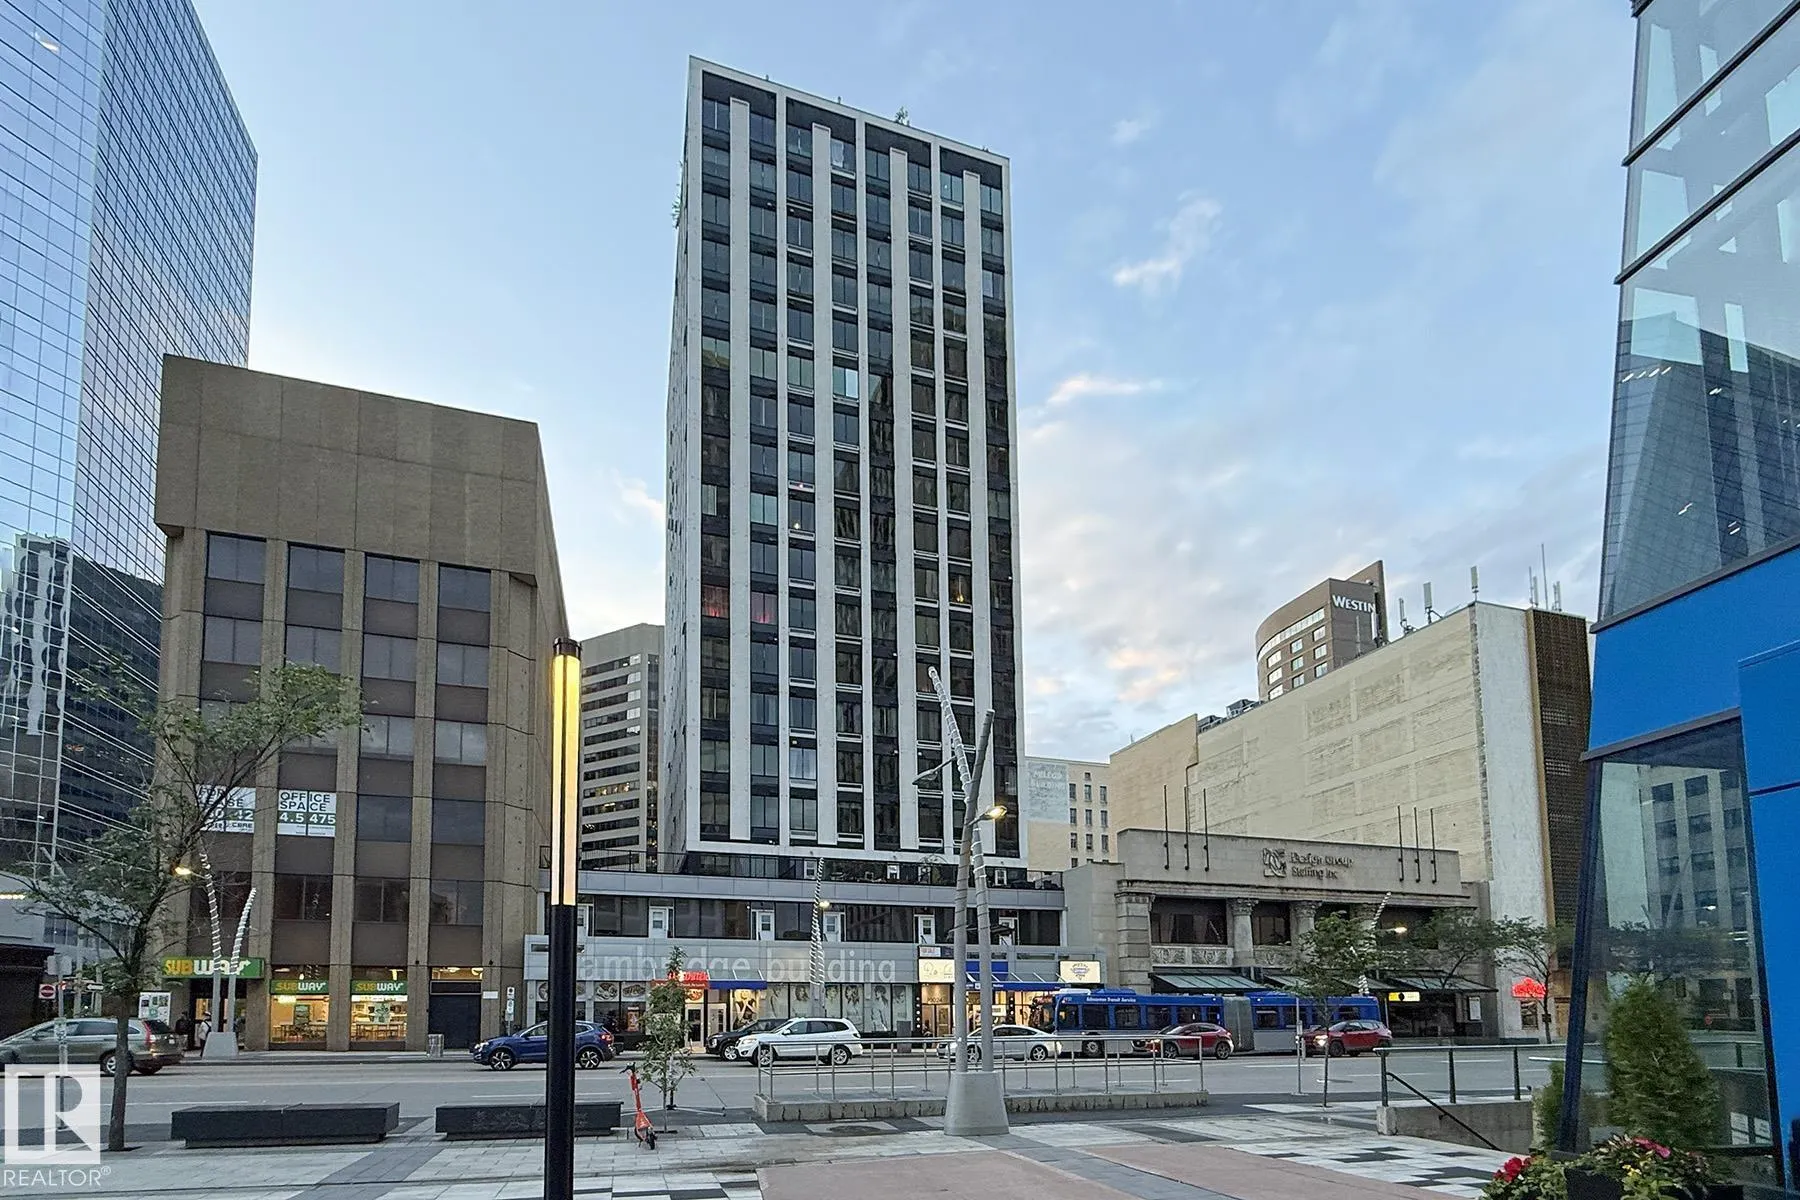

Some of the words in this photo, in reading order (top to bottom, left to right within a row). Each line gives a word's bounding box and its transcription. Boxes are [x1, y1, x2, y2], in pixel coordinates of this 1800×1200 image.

[1332, 595, 1375, 612] WESTIN
[163, 959, 251, 976] SUBWAY
[767, 947, 896, 982] buding
[275, 982, 326, 991] SUBWAY
[355, 982, 404, 991] SUBWAY
